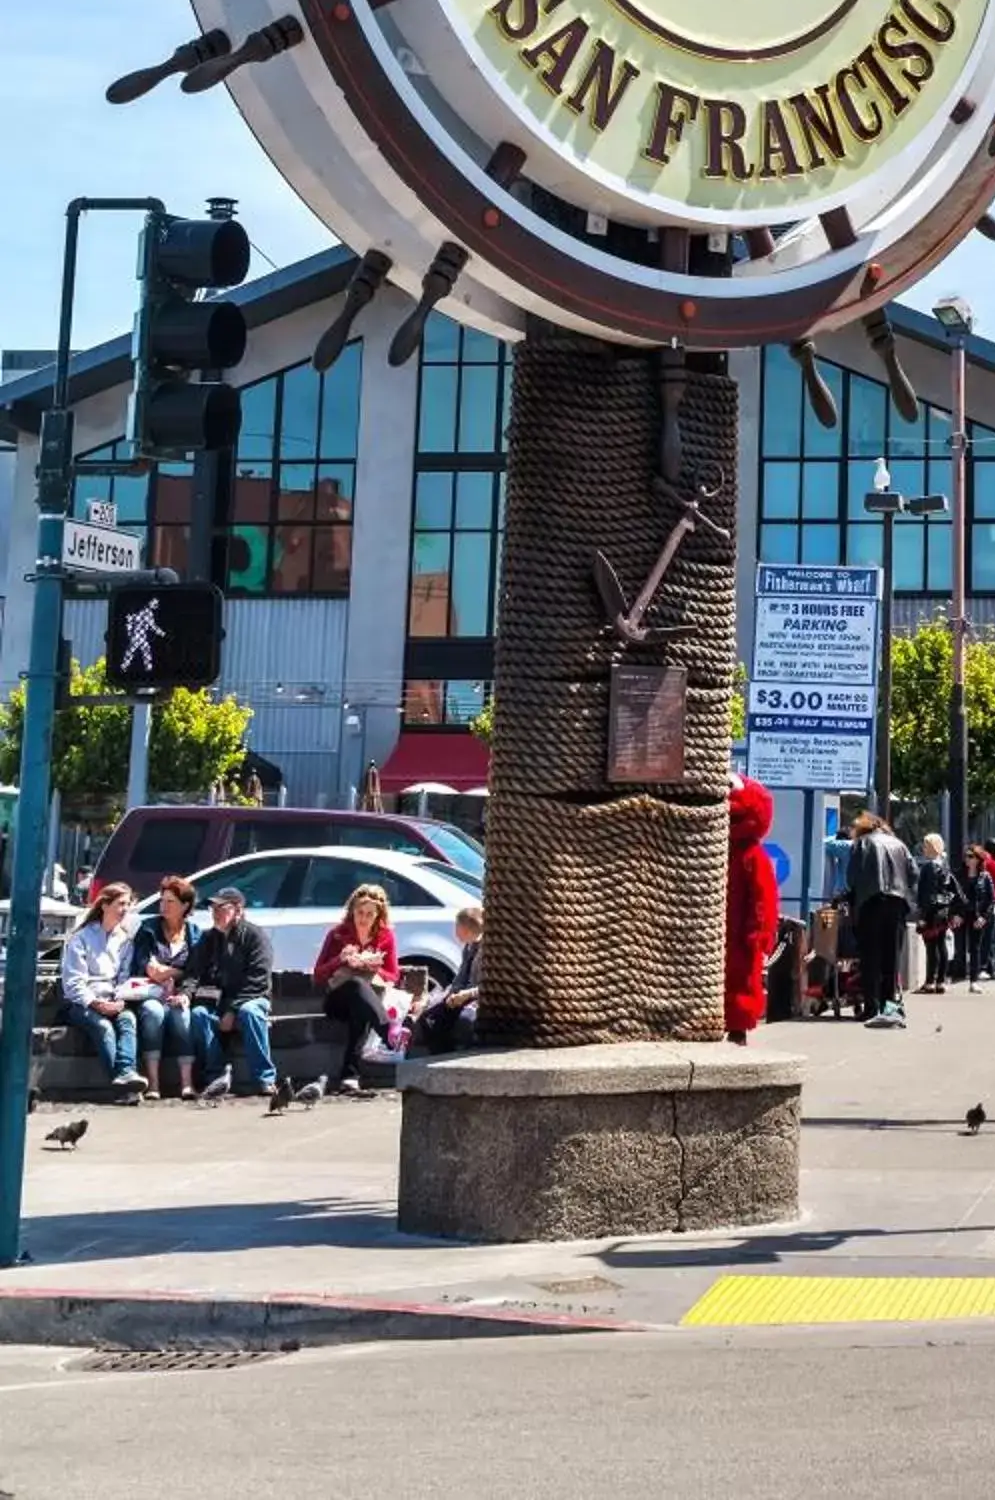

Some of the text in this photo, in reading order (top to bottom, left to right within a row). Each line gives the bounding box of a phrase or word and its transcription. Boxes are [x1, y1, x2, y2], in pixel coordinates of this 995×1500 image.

[67, 530, 134, 569] Jefferson
[835, 572, 872, 594] Wharf
[791, 604, 799, 617] 3
[801, 604, 839, 617] HOURS
[841, 605, 865, 617] FREE
[782, 618, 849, 632] PARKING
[757, 689, 823, 711] $3.00
[827, 693, 852, 702] EACH
[826, 703, 868, 713] MINUTES
